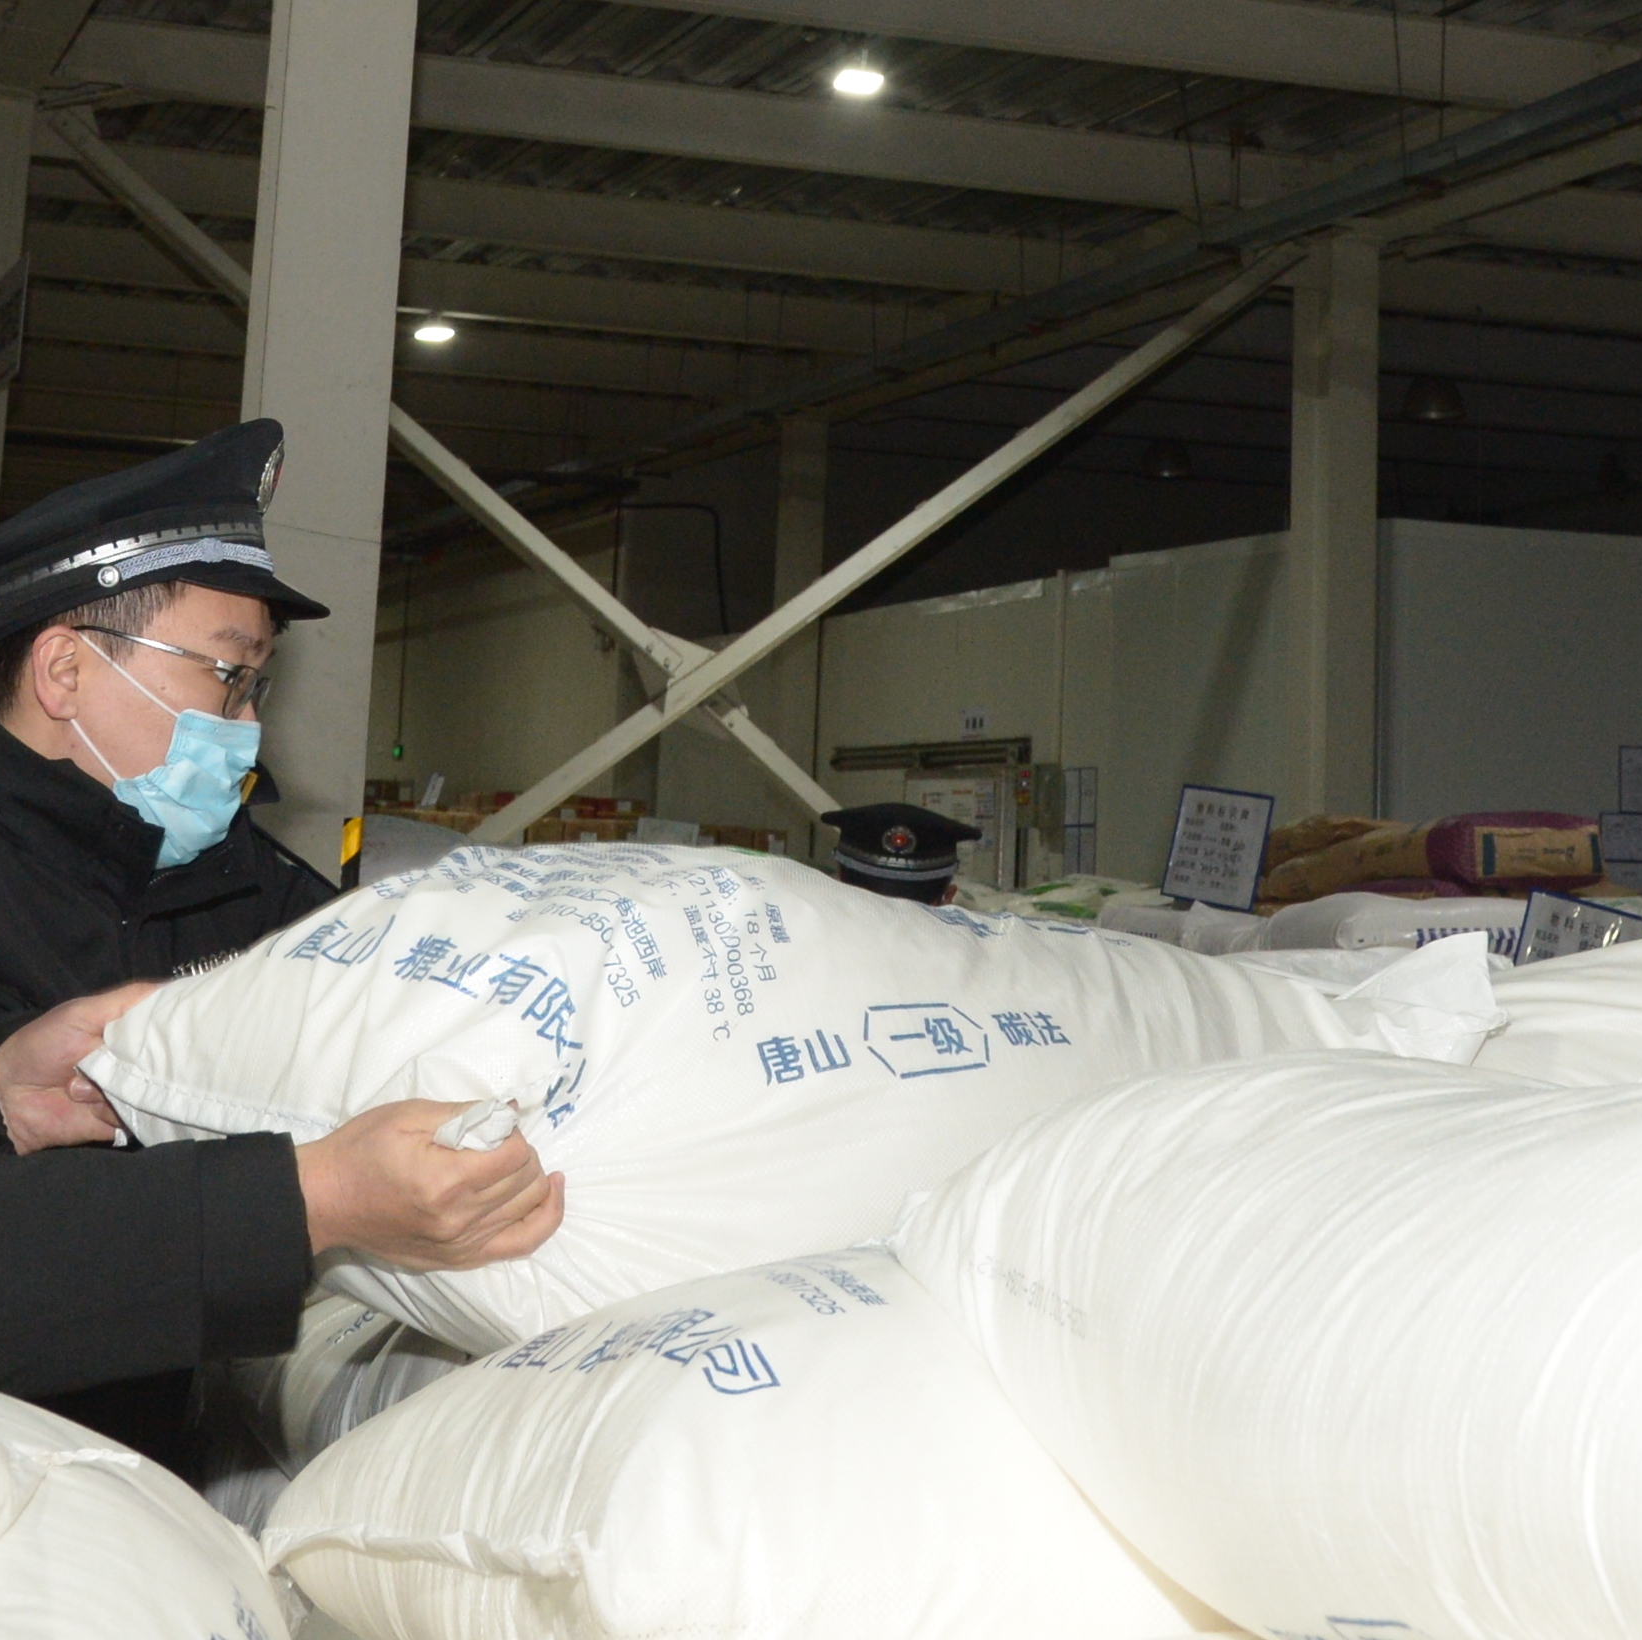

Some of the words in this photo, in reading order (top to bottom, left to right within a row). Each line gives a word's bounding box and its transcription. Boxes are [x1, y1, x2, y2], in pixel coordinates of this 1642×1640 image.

[537, 902, 642, 1008] 010-85017325
[756, 1028, 853, 1087] 唐山
[889, 1017, 973, 1056] 一级
[991, 1010, 1072, 1047] 碳法
